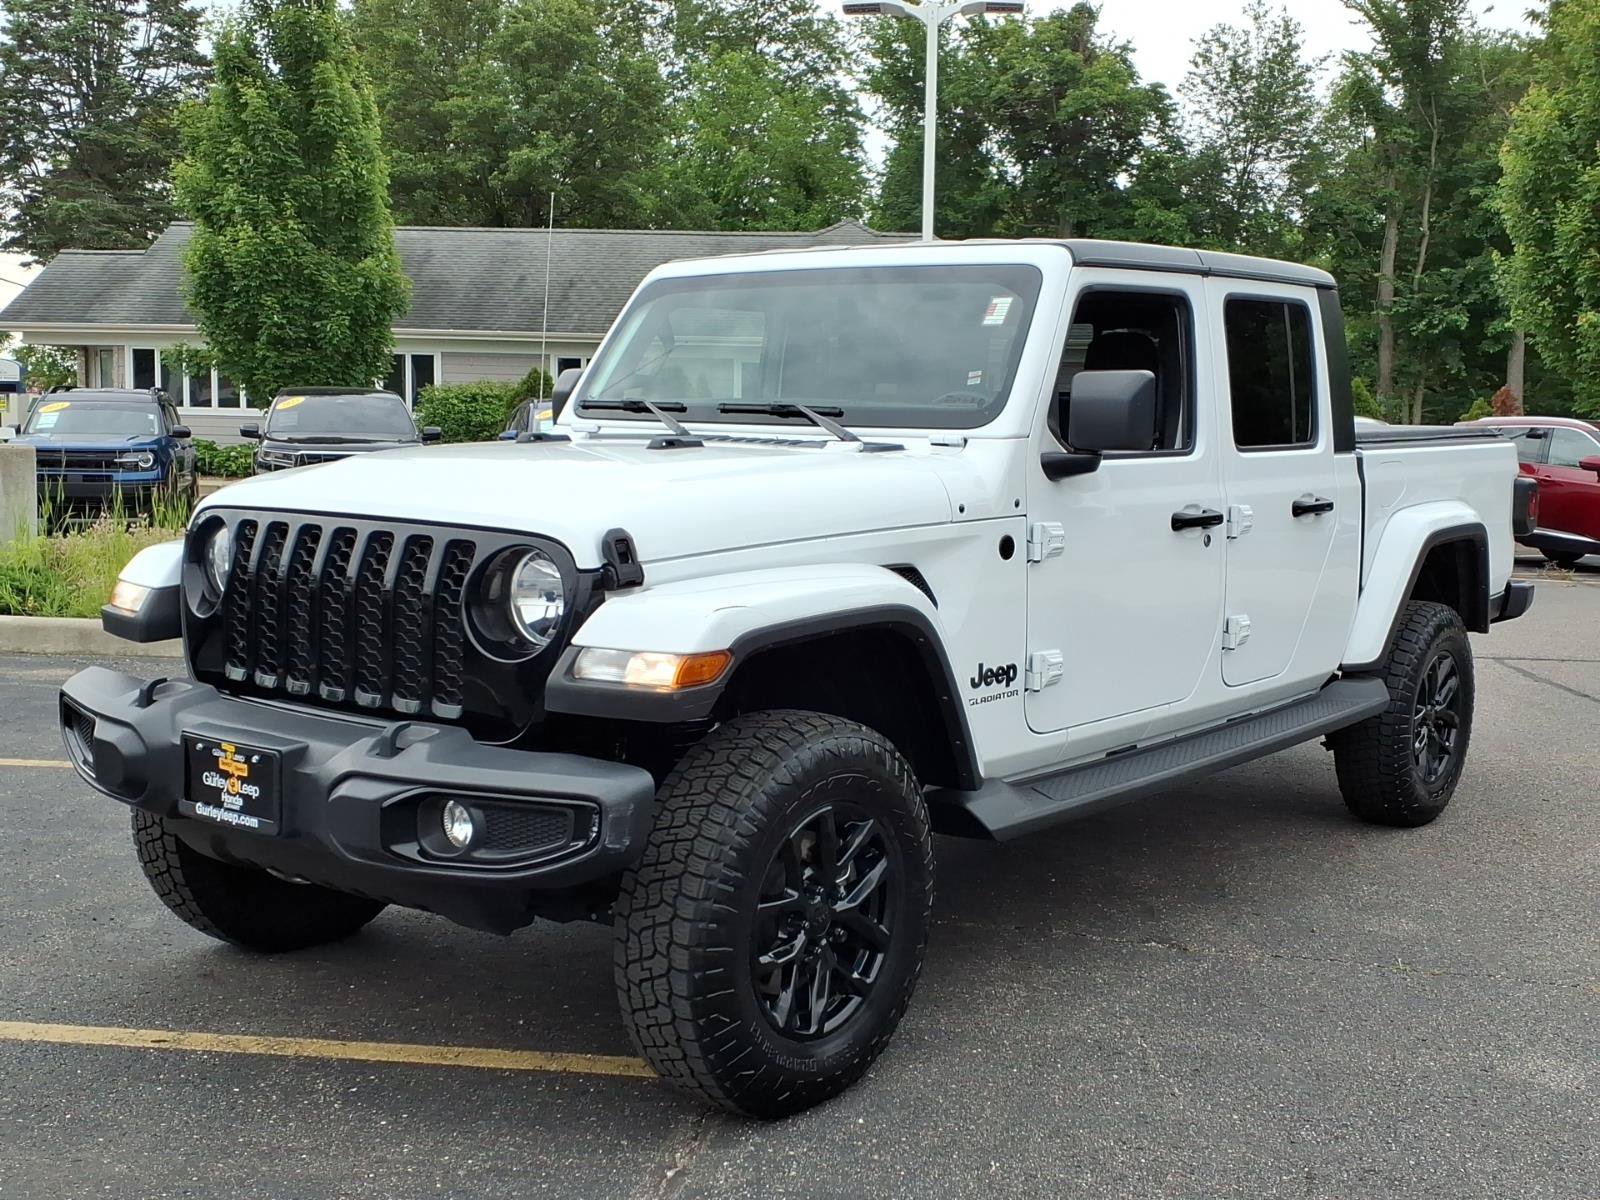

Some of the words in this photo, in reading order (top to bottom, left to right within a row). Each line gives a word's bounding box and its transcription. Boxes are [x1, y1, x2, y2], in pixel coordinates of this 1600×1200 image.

[970, 663, 1017, 689] Jeep
[969, 689, 1018, 706] GLADIATOR
[203, 772, 229, 792] Gurley
[239, 780, 259, 799] Leep
[221, 792, 243, 806] Honda
[195, 802, 258, 828] Gurleyleep.com
